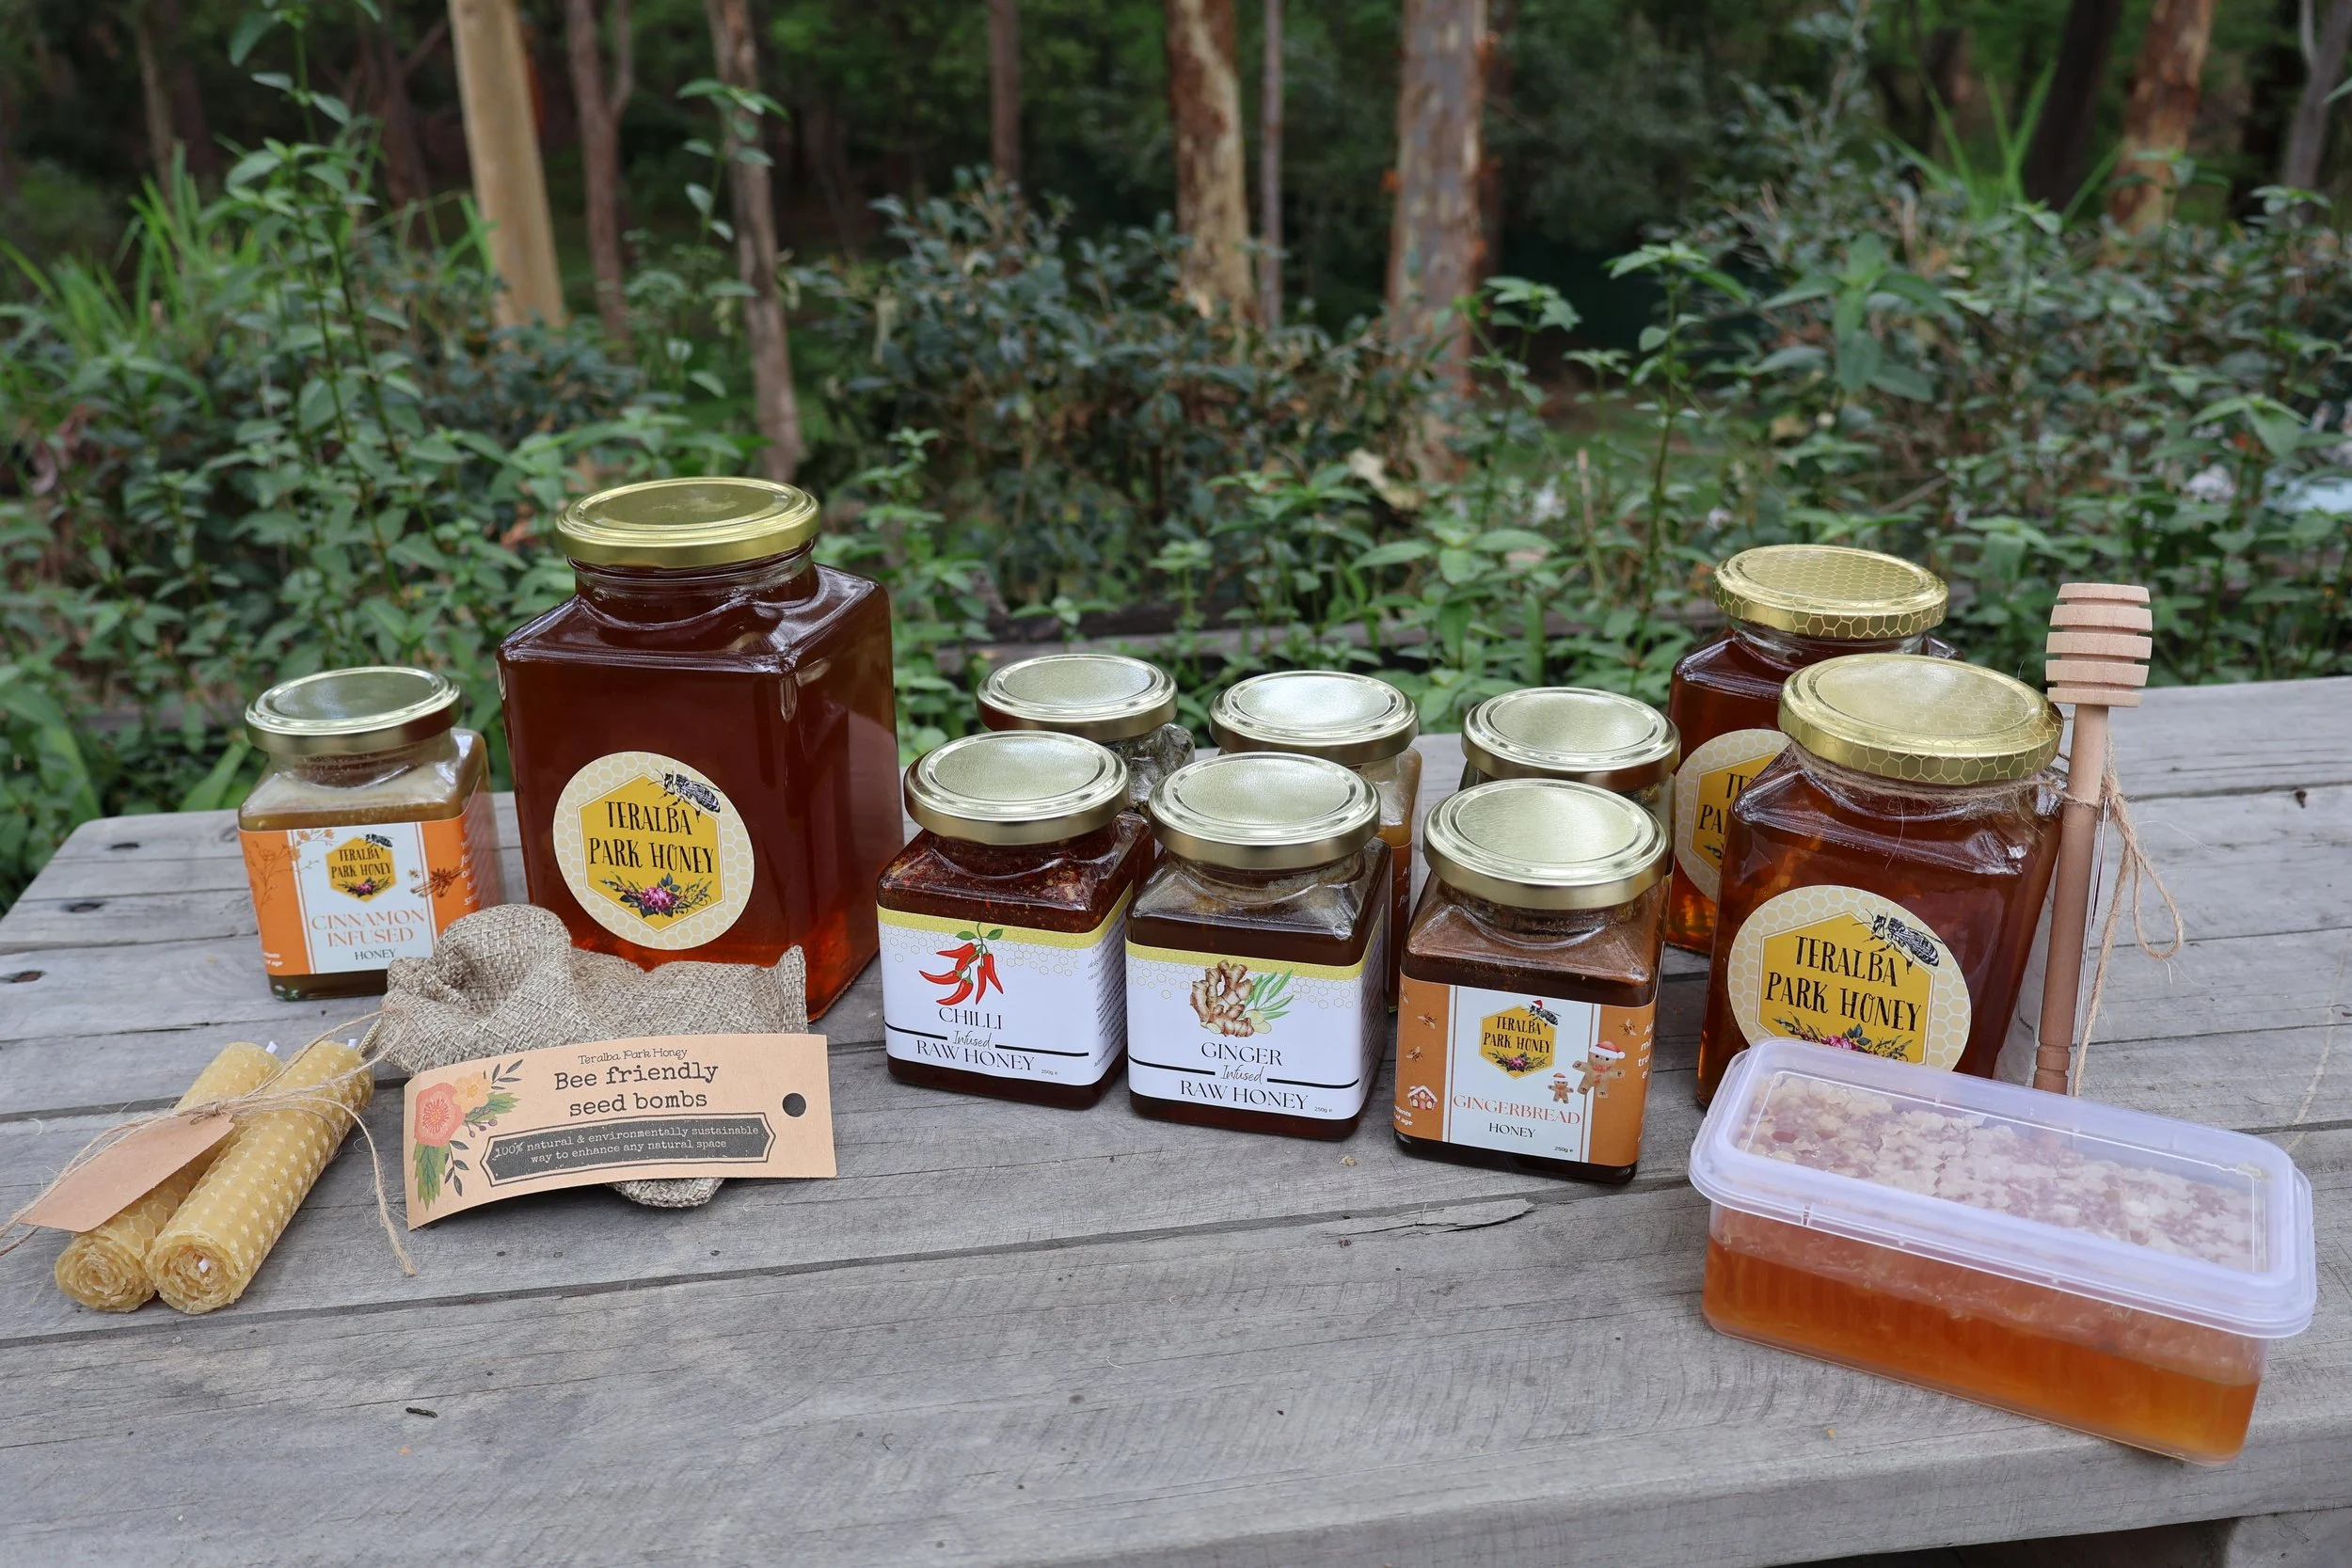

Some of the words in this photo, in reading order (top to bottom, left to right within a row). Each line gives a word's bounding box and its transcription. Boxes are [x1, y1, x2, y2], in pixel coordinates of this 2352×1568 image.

[605, 801, 692, 835] TERALBA
[339, 847, 380, 862] TERALBA
[589, 837, 643, 868] PARK
[649, 842, 714, 874] HONEY
[331, 865, 357, 879] PARK
[361, 863, 392, 876] HONEY
[311, 909, 426, 931] CINNAMON
[328, 927, 414, 947] INFUSED
[355, 948, 396, 960] HONEY
[1795, 935, 1898, 987] TERALBA
[1765, 972, 1828, 1013] PARK
[1840, 988, 1921, 1032] HONEY
[939, 1006, 1003, 1030] CHILLI
[1496, 1016, 1542, 1036] TERALBA
[952, 1030, 993, 1050] Infused
[1483, 1032, 1511, 1049] PARK
[1517, 1037, 1552, 1053] HONEY
[578, 1053, 621, 1065] Teralba
[623, 1049, 651, 1059] Park
[653, 1048, 688, 1060] Honey
[916, 1039, 960, 1061] RAW
[965, 1050, 1035, 1071] HONEY
[1201, 1041, 1283, 1067] GINGER
[554, 1072, 597, 1090] Bee
[606, 1062, 719, 1085] friendly
[1220, 1065, 1263, 1083] Infused
[569, 1094, 627, 1117] seed
[633, 1090, 707, 1110] bombs
[1180, 1080, 1227, 1101] RAW
[1233, 1087, 1309, 1111] HONEY
[1454, 1094, 1581, 1125] GINGERBREAD
[495, 1141, 524, 1158] 100%
[527, 1136, 573, 1151] natural
[577, 1134, 585, 1144] &
[588, 1127, 689, 1144] environmentally
[691, 1126, 759, 1135] sustainable
[1489, 1122, 1535, 1138] HONEY
[531, 1152, 552, 1164] way
[556, 1150, 569, 1160] to
[572, 1145, 620, 1157] enhance
[623, 1142, 644, 1152] any
[648, 1140, 693, 1149] natural
[697, 1140, 727, 1149] space
